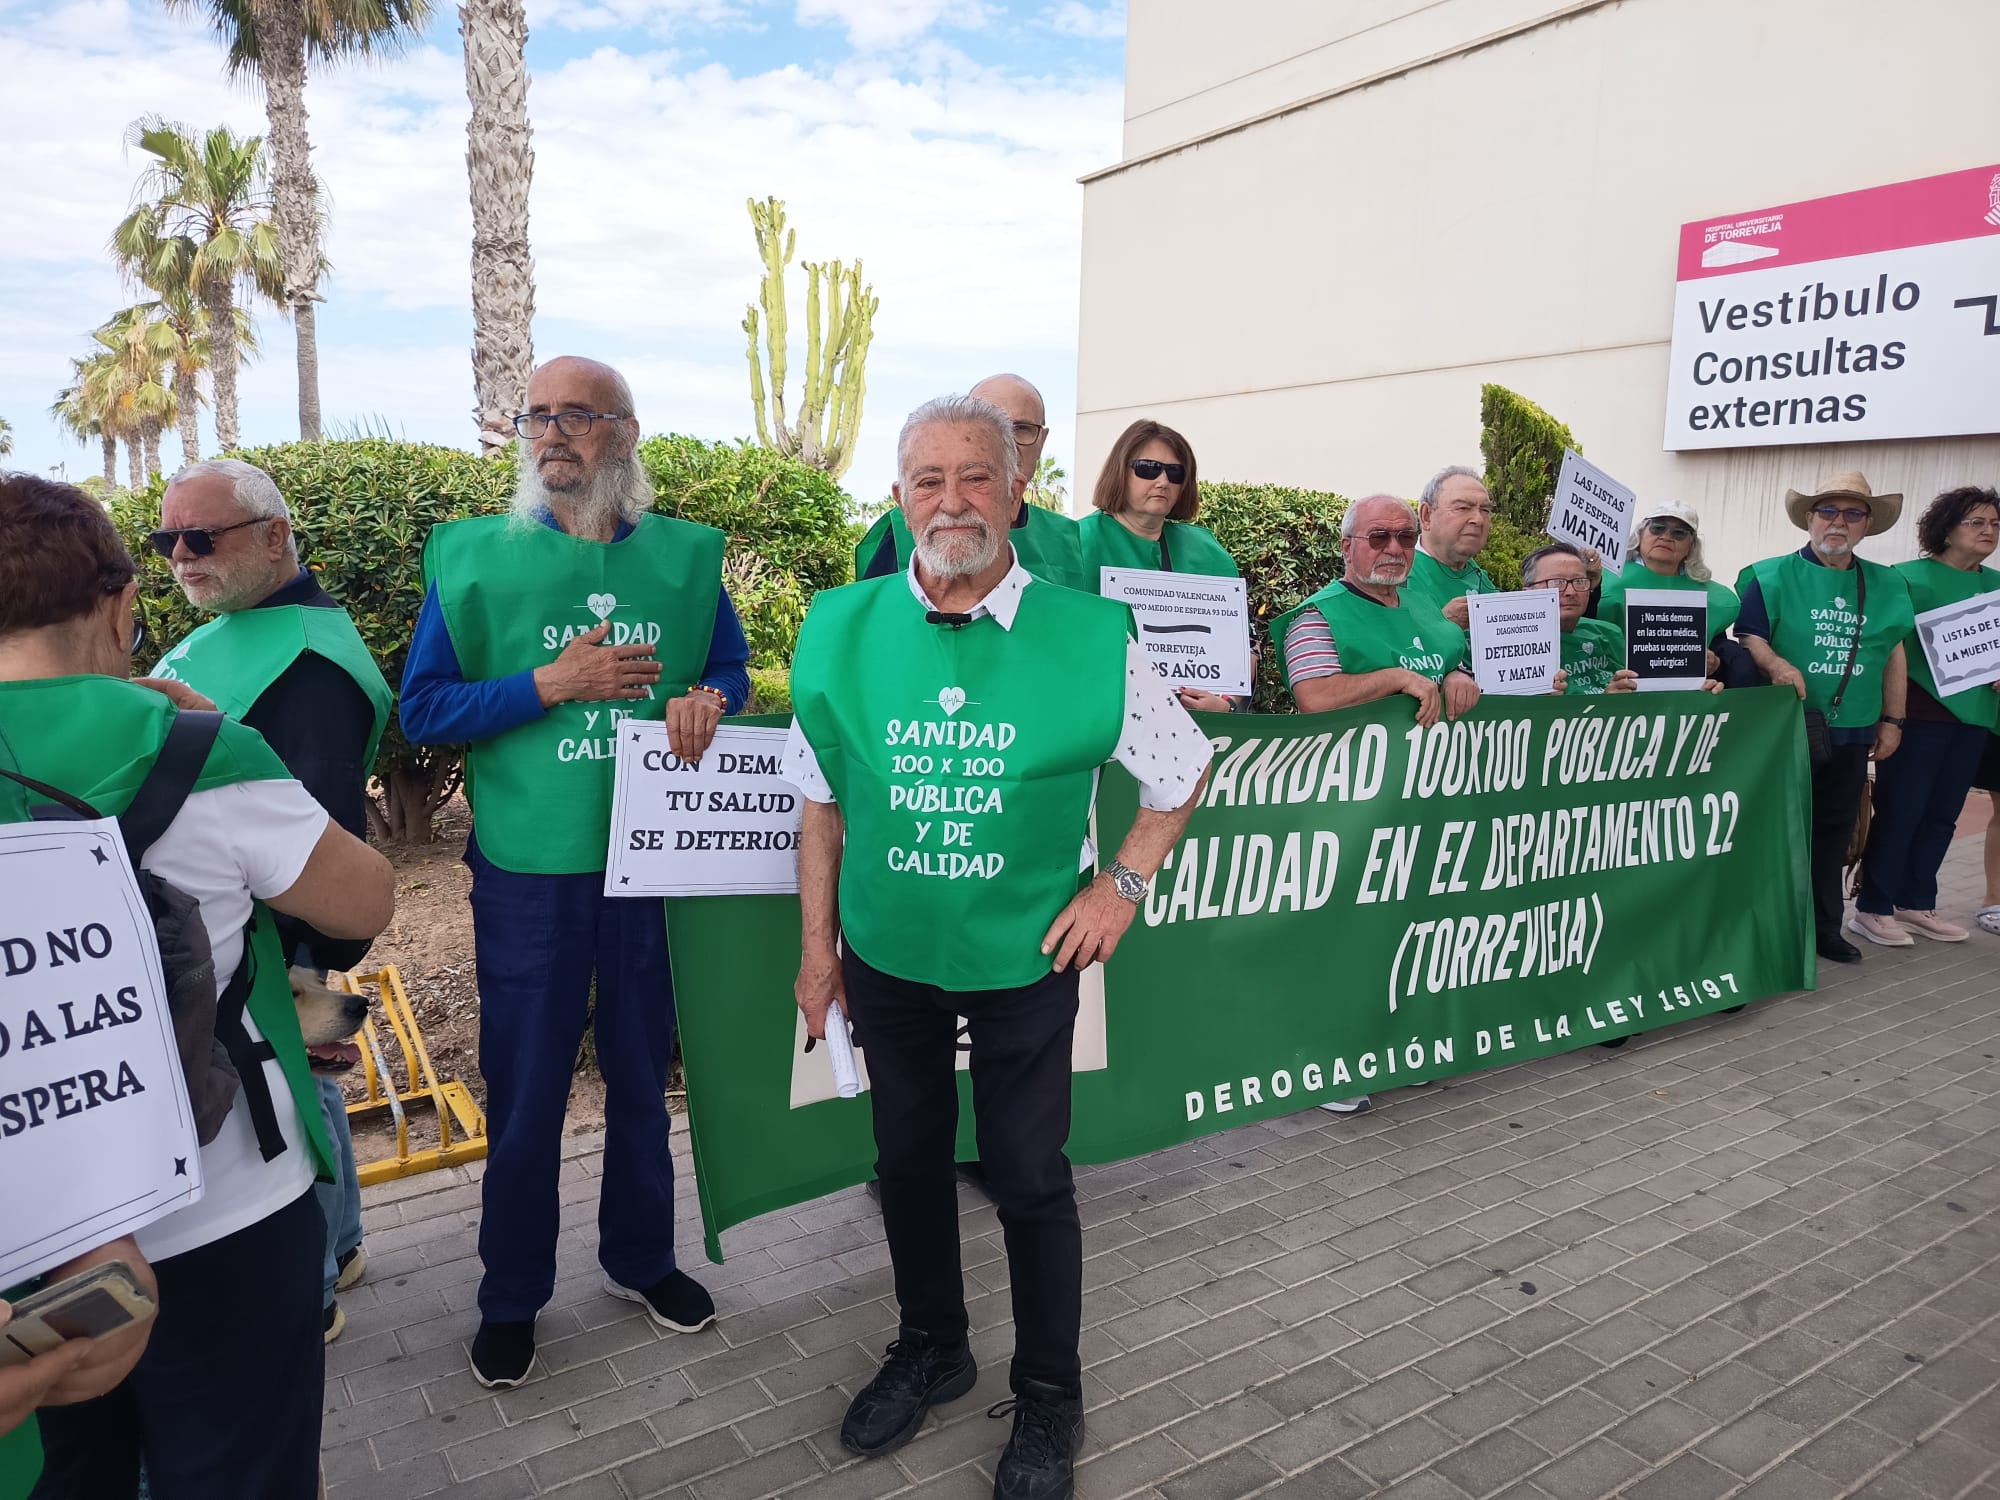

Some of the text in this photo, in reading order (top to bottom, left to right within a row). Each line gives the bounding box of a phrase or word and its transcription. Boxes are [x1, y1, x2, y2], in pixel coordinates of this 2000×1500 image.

[1704, 222, 1782, 243] DE TORREVIEJA
[1705, 214, 1783, 233] HOSPITAL UNIVERSITARIO
[1698, 273, 1920, 333] Vestíbulo
[1692, 336, 1906, 386] Consultas
[1688, 394, 1867, 431] externas
[1574, 472, 1625, 513] LAS LISTAS
[1570, 492, 1619, 533] DE ESPERA
[1561, 508, 1620, 561] MATAN
[1123, 586, 1227, 602] COMUNIDAD VALENCIANA
[1130, 602, 1147, 611] MPO
[1147, 604, 1173, 613] MEDIO
[1174, 606, 1184, 614] DE
[1184, 607, 1211, 616] ESPERA
[1221, 608, 1239, 617] DÍAS
[1486, 611, 1546, 624] LAS DEMORAS EN LOS
[1655, 612, 1669, 622] más
[1669, 612, 1694, 622] demora
[1810, 608, 1867, 626] SANIDAD
[1496, 624, 1539, 636] DIAGNÓSTICOS
[1636, 629, 1646, 637] en
[1646, 627, 1656, 637] las
[1656, 627, 1673, 637] citas
[1815, 622, 1835, 632] 100
[1942, 625, 1977, 644] LISTAS
[1977, 620, 1993, 632] DE
[1145, 642, 1206, 657] TORREVIEJA
[1485, 641, 1552, 660] DETERIORAN
[1633, 642, 1702, 654] pruebas u operaciones
[1826, 649, 1851, 661] Y DE
[1945, 639, 2000, 663] LA MUERTE
[1170, 659, 1221, 680] AÑOS
[1497, 665, 1546, 683] Y MATAN
[584, 710, 600, 731] Y
[885, 719, 1017, 752] SANIDAD
[557, 738, 617, 763] CALI
[642, 750, 784, 775] CON DEM
[1401, 717, 1532, 800] 100X100
[1541, 704, 1666, 787] PÚBLICA
[1665, 713, 1698, 777] Y
[1686, 712, 1730, 776] DE
[891, 754, 934, 774] 100
[962, 757, 1005, 777] 100
[666, 790, 795, 813] TU SALUD
[890, 778, 1003, 815] PÚBLICA
[629, 829, 664, 851] SE
[915, 820, 974, 847] Y DE
[887, 846, 1005, 881] CALIDAD
[1144, 790, 1740, 928] CALIDAD EN EL DEPARTAMENTO 22
[46, 922, 112, 968] NO
[1388, 891, 1604, 1014] (TORREVIEJA)
[22, 1009, 56, 1051] A
[57, 985, 143, 1039] LAS
[1185, 1036, 1455, 1122] DEROGACIÓN
[1476, 1024, 1516, 1057] DE
[1534, 1014, 1572, 1043] LA
[1587, 994, 1645, 1031] LEY
[0, 1059, 146, 1140] SPERA
